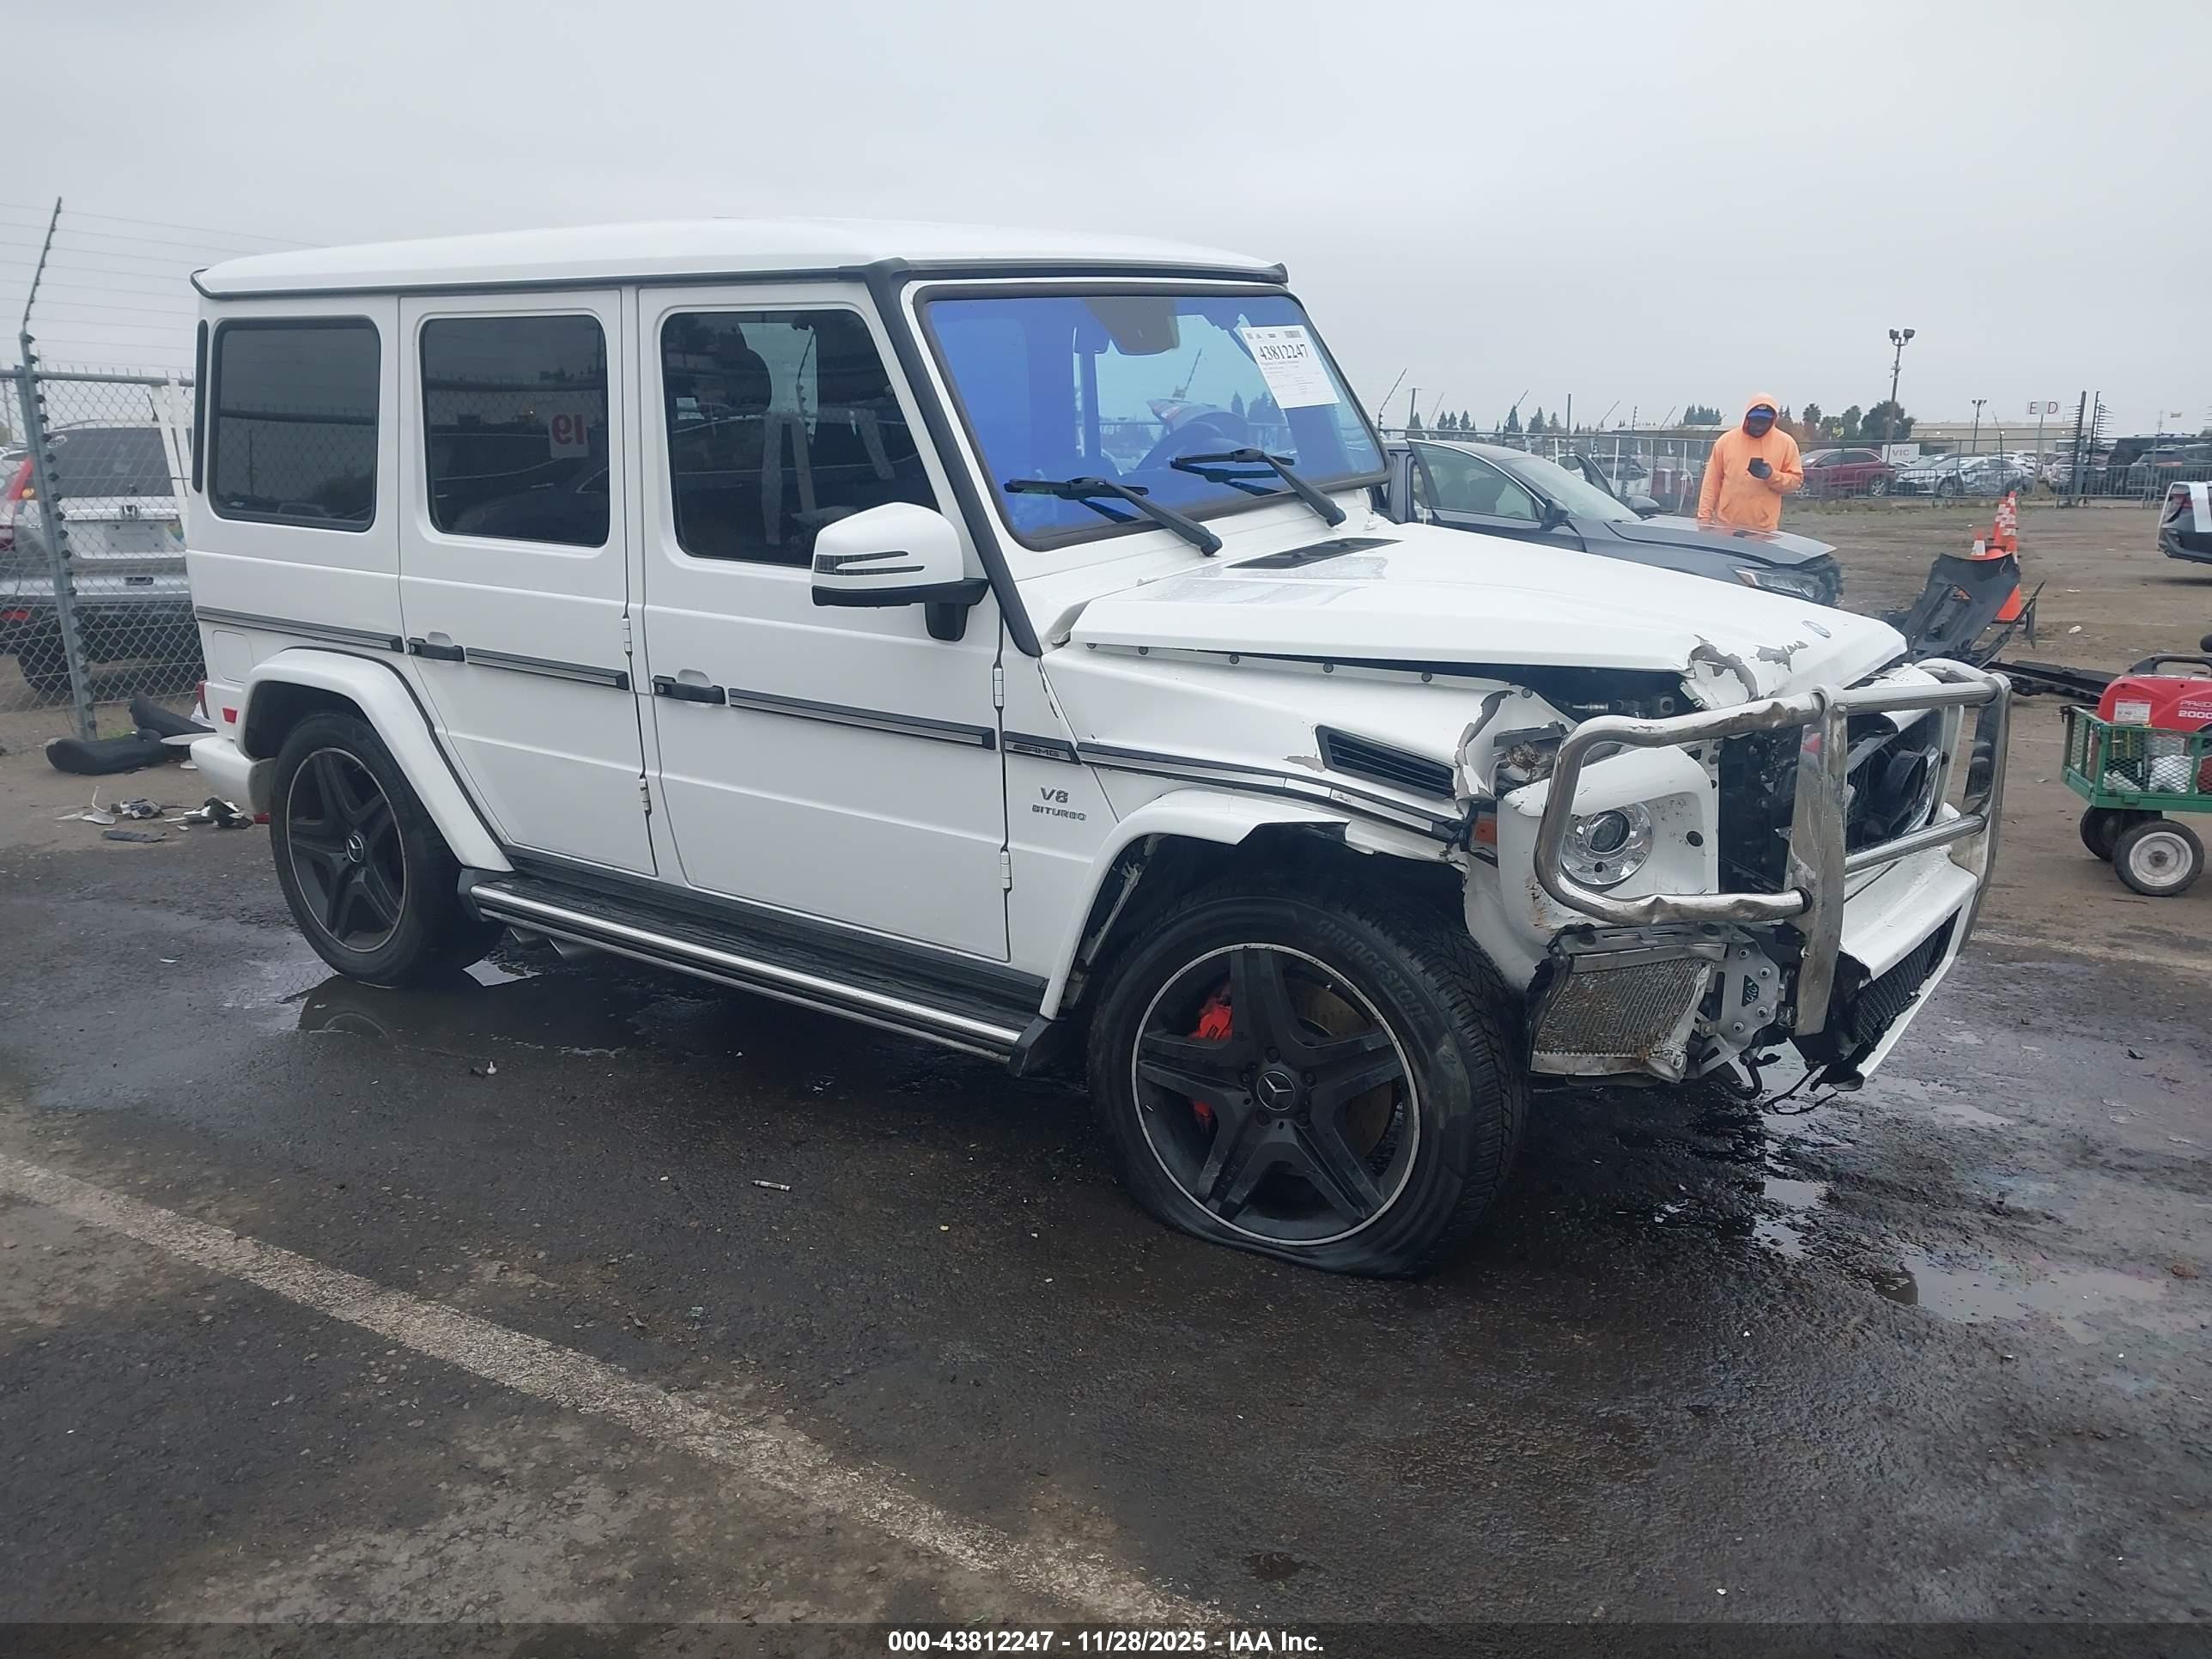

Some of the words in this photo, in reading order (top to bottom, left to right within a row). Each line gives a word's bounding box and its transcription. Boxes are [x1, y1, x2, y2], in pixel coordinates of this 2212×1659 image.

[1259, 343, 1309, 361] 43812247
[1040, 786, 1069, 804] V8
[1031, 804, 1087, 821] BITURBO
